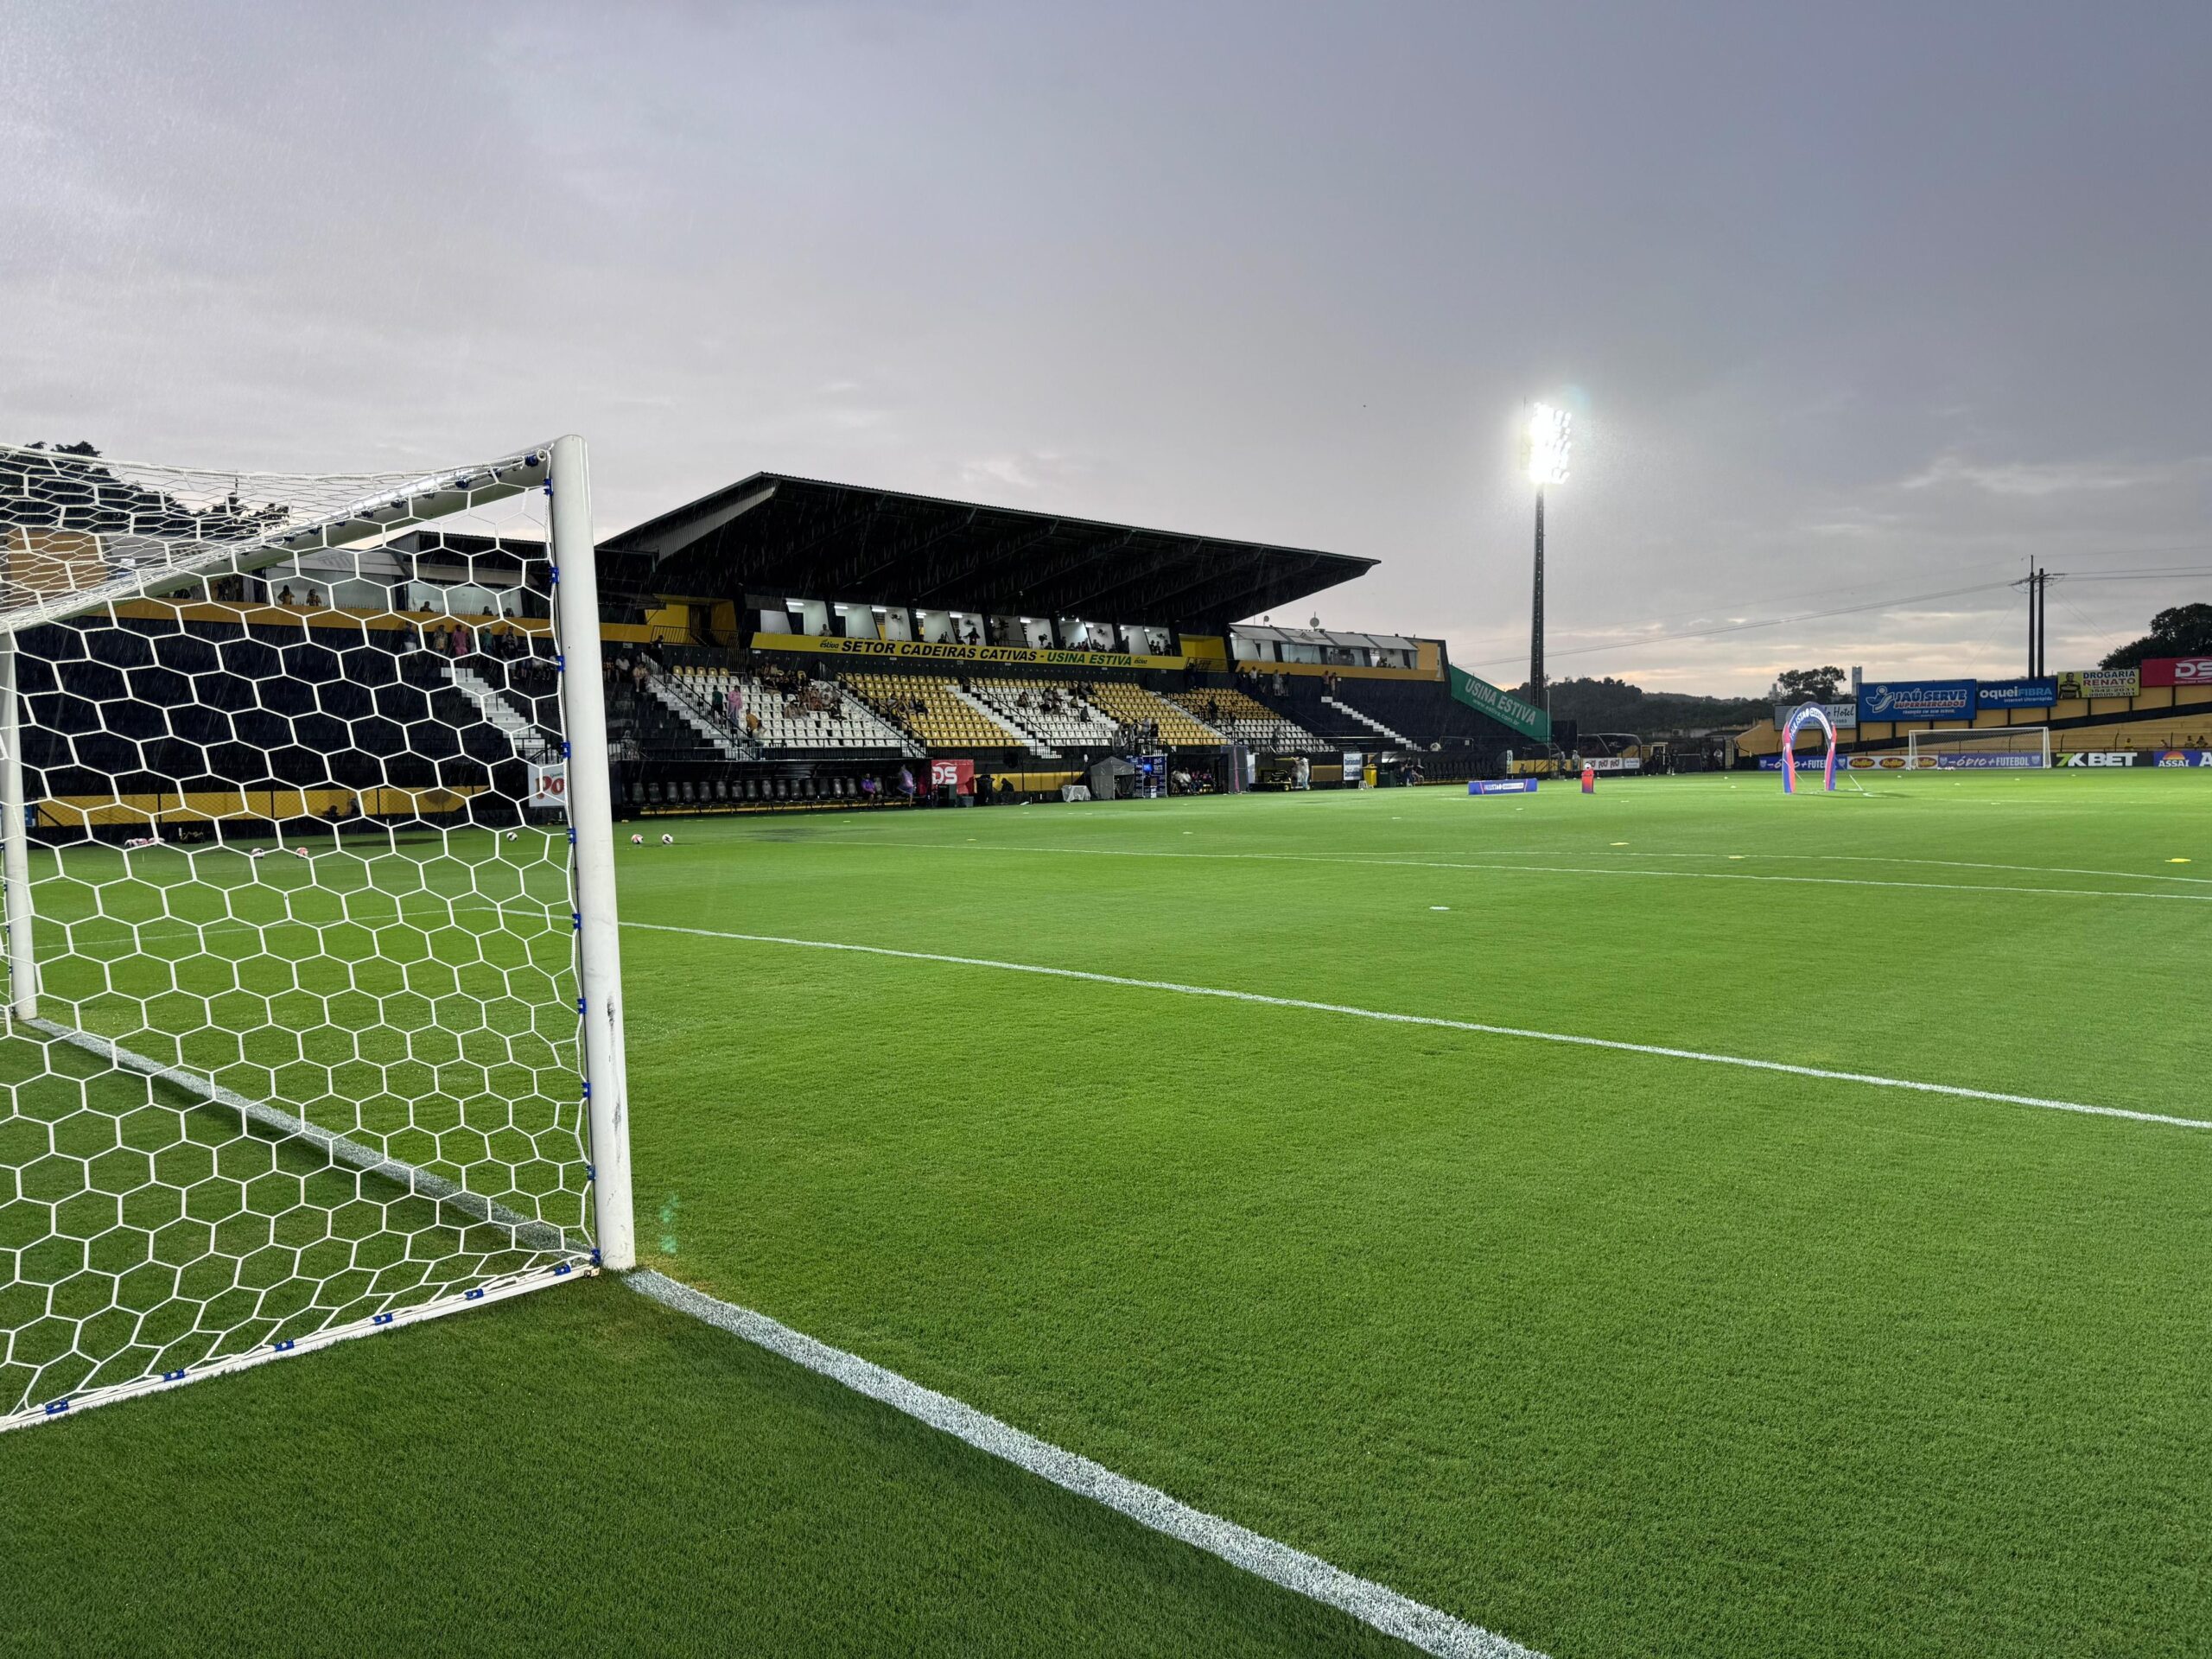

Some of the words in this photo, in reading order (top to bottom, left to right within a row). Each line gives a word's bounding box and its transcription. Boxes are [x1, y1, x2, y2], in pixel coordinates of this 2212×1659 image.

[842, 640, 895, 654] SETOR
[900, 644, 976, 658] CADEIRAS
[980, 648, 1037, 661] CATIVAS
[1046, 652, 1085, 664] USINA
[1089, 654, 1132, 666] ESTIVA
[2082, 671, 2136, 679] DROGARIA
[1465, 678, 1497, 706] USINA
[1497, 695, 1536, 726] ESTIVA
[1894, 688, 1922, 702] JAÚ
[1923, 690, 1967, 702] SERVE
[1472, 698, 1520, 726] www.estiva.com.br
[1834, 705, 1855, 717] Hotel
[1894, 700, 1966, 709] SUPERMERCADOS
[931, 766, 957, 785] DS
